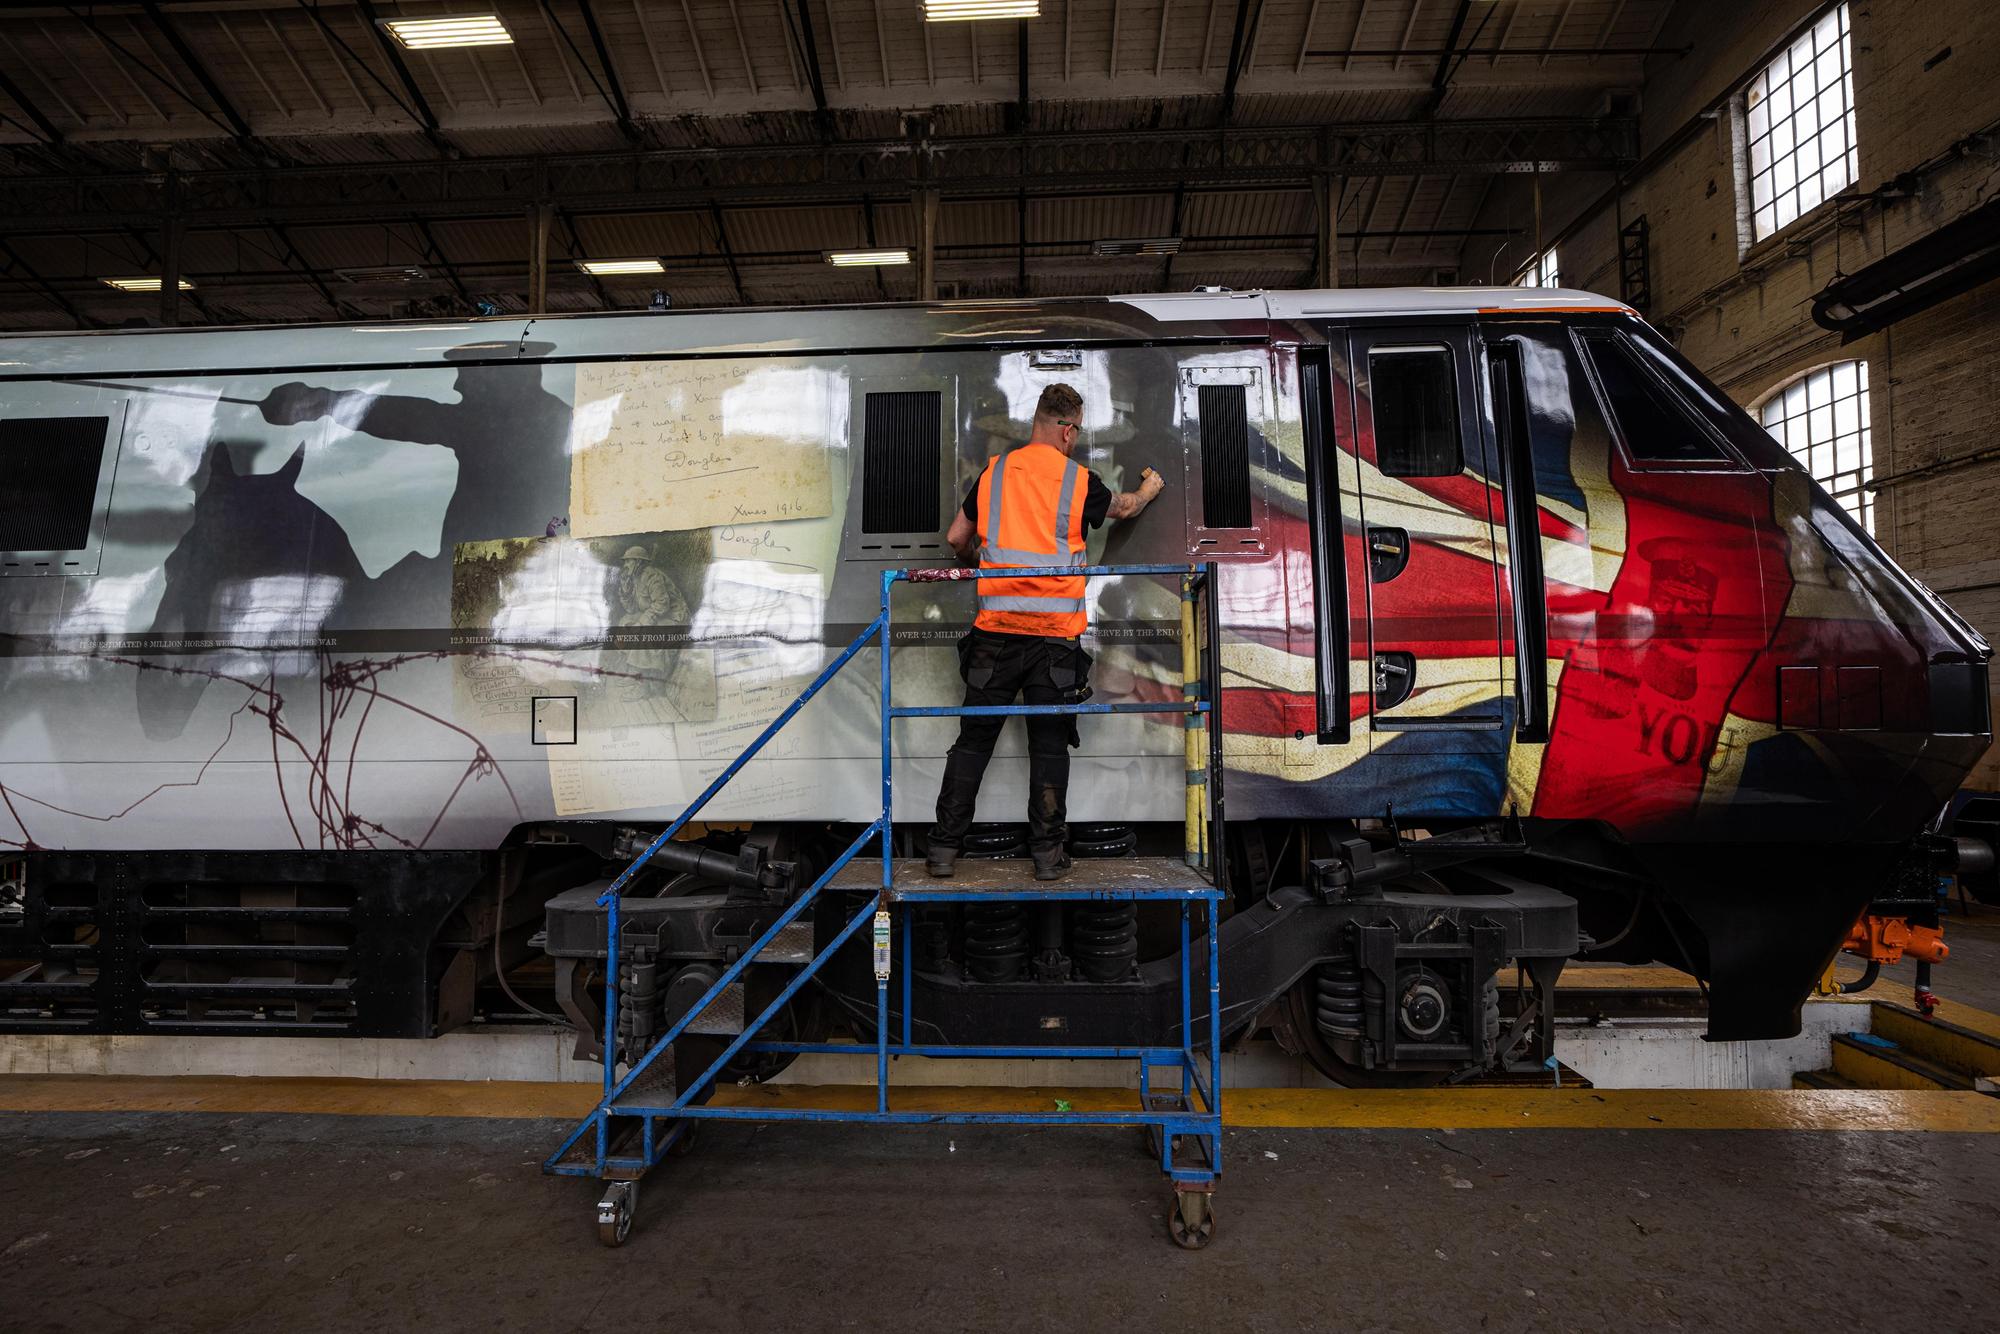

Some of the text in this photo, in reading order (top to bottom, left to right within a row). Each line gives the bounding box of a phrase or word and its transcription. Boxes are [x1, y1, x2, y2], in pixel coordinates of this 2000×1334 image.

[895, 631, 919, 640] OVER
[1123, 628, 1134, 637] BY
[1136, 628, 1154, 637] THE
[1156, 628, 1174, 637] END
[150, 640, 182, 649] MILLION
[184, 639, 214, 648] HORSES
[270, 638, 299, 647] DURING
[318, 638, 337, 646] WAR
[465, 636, 499, 645] MILLION
[587, 634, 614, 643] EVERY
[616, 633, 640, 642] WEEK
[641, 633, 666, 642] FROM
[668, 633, 691, 642] HOME
[1632, 700, 1738, 774] YOU
